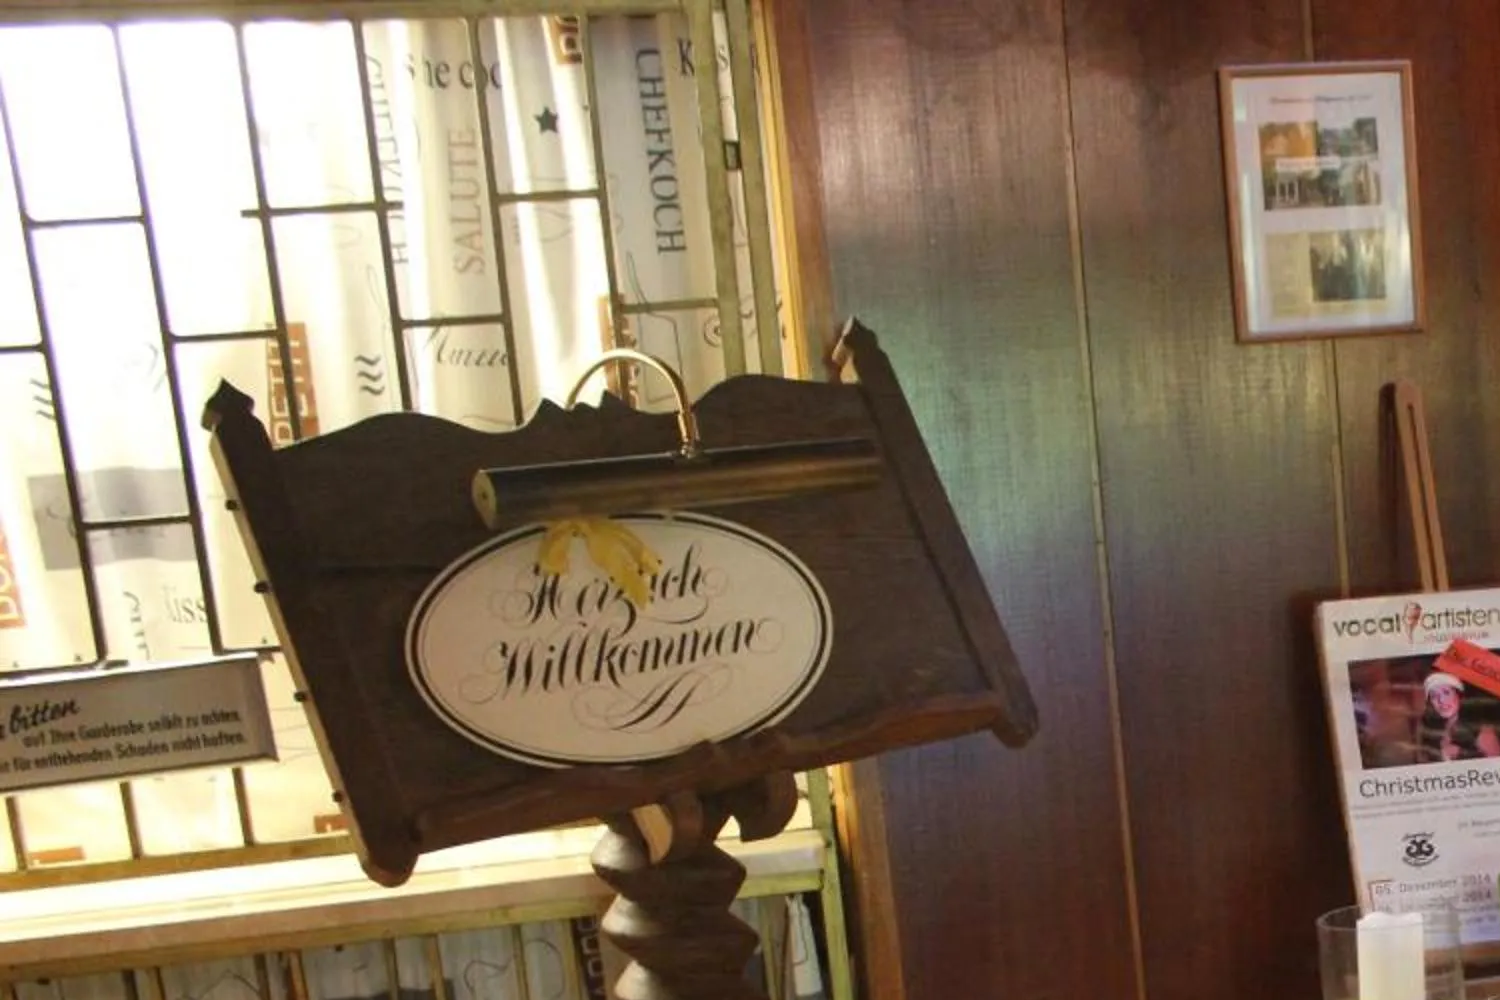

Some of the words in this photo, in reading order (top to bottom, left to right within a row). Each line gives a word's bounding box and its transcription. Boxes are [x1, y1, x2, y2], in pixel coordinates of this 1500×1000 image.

[634, 48, 687, 255] CHEFKOCH
[448, 128, 486, 277] SALUTE
[505, 544, 728, 638] Herzich
[1333, 616, 1401, 638] vocal
[482, 618, 782, 695] Willkommen
[10, 699, 80, 734] bitten
[23, 731, 46, 749] auf
[78, 720, 144, 741] Garderobe
